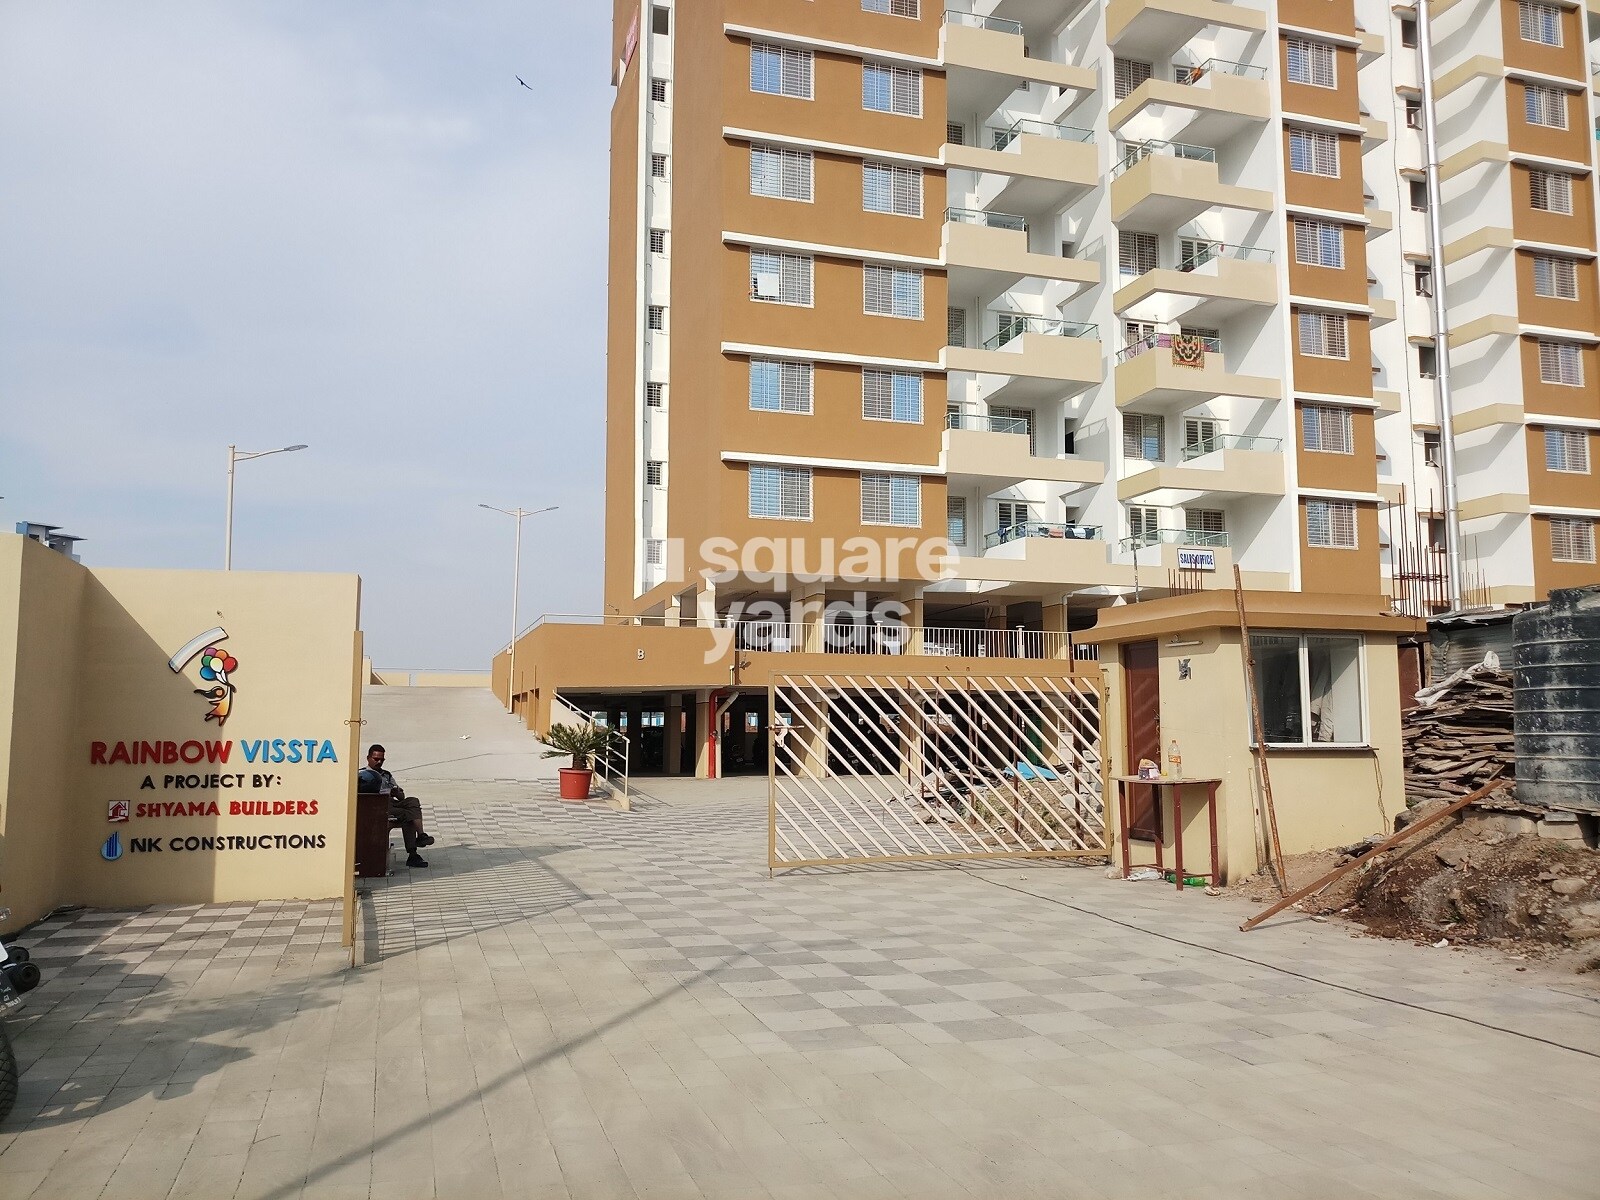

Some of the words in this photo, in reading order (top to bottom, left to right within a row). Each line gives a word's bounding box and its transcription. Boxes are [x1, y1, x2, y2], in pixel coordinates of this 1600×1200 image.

[637, 648, 646, 661] B
[90, 740, 233, 764] RAINBOW
[241, 739, 338, 763] VISSTA
[140, 775, 155, 789] A
[164, 774, 245, 789] PROJECT
[252, 774, 282, 788] BY:
[135, 802, 220, 817] SHYAMA
[229, 800, 319, 816] BUILDERS
[130, 837, 163, 852] NK
[169, 834, 326, 851] CONSTRUCTIONS
